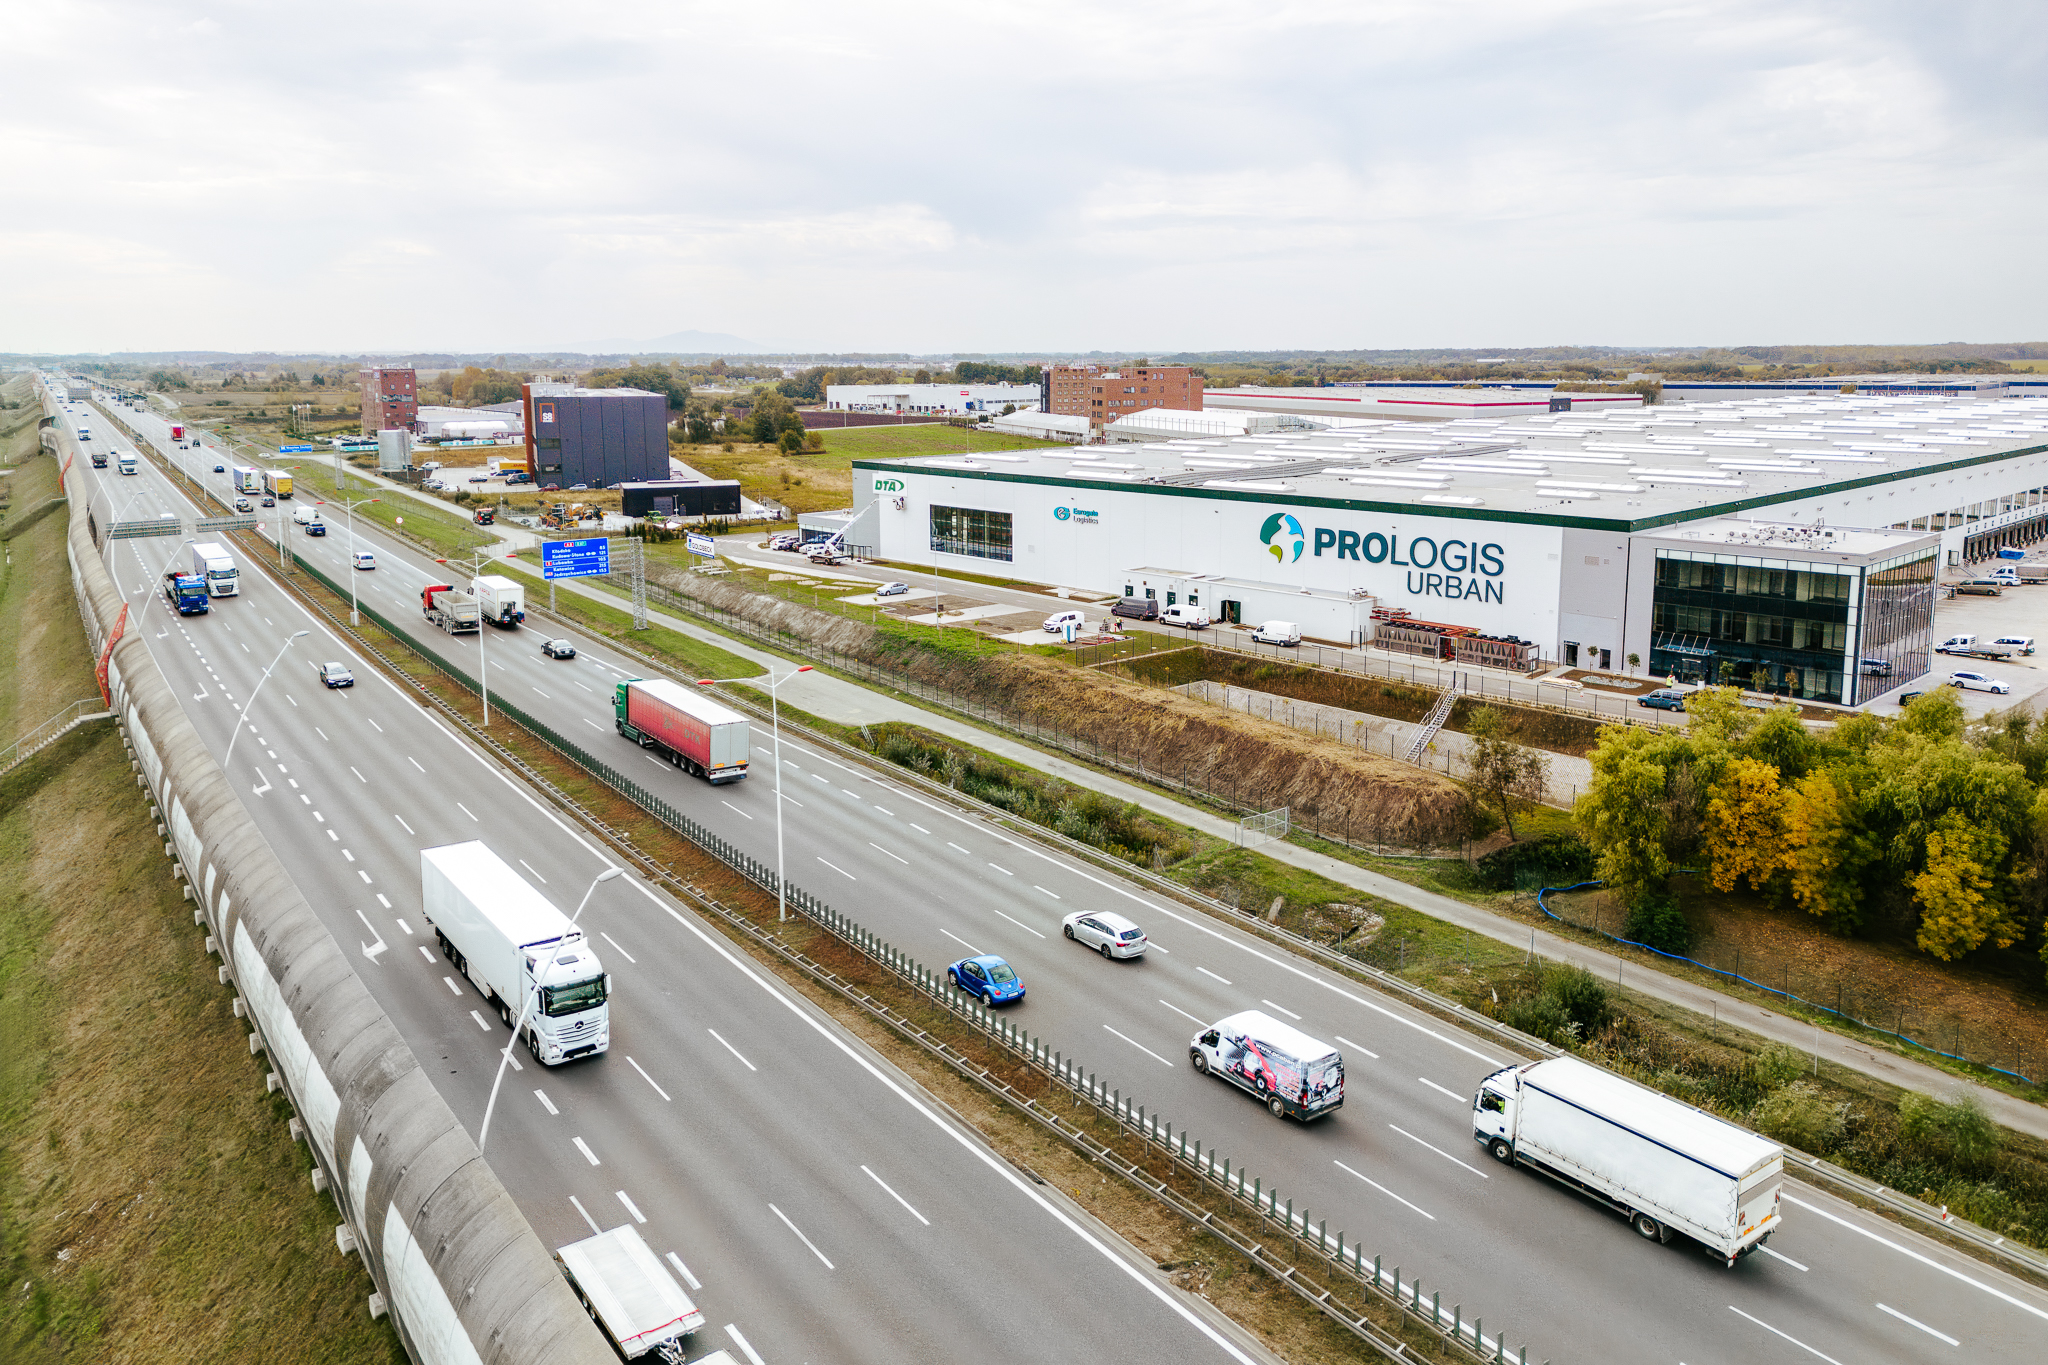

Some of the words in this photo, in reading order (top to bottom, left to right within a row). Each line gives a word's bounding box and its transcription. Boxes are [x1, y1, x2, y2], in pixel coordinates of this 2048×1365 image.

[875, 480, 896, 492] DTA
[1073, 515, 1099, 525] Logistics
[692, 542, 712, 553] GOLDBECK
[1314, 527, 1505, 577] PROLOGIS
[1407, 570, 1504, 605] URBAN
[684, 728, 701, 745] DTK
